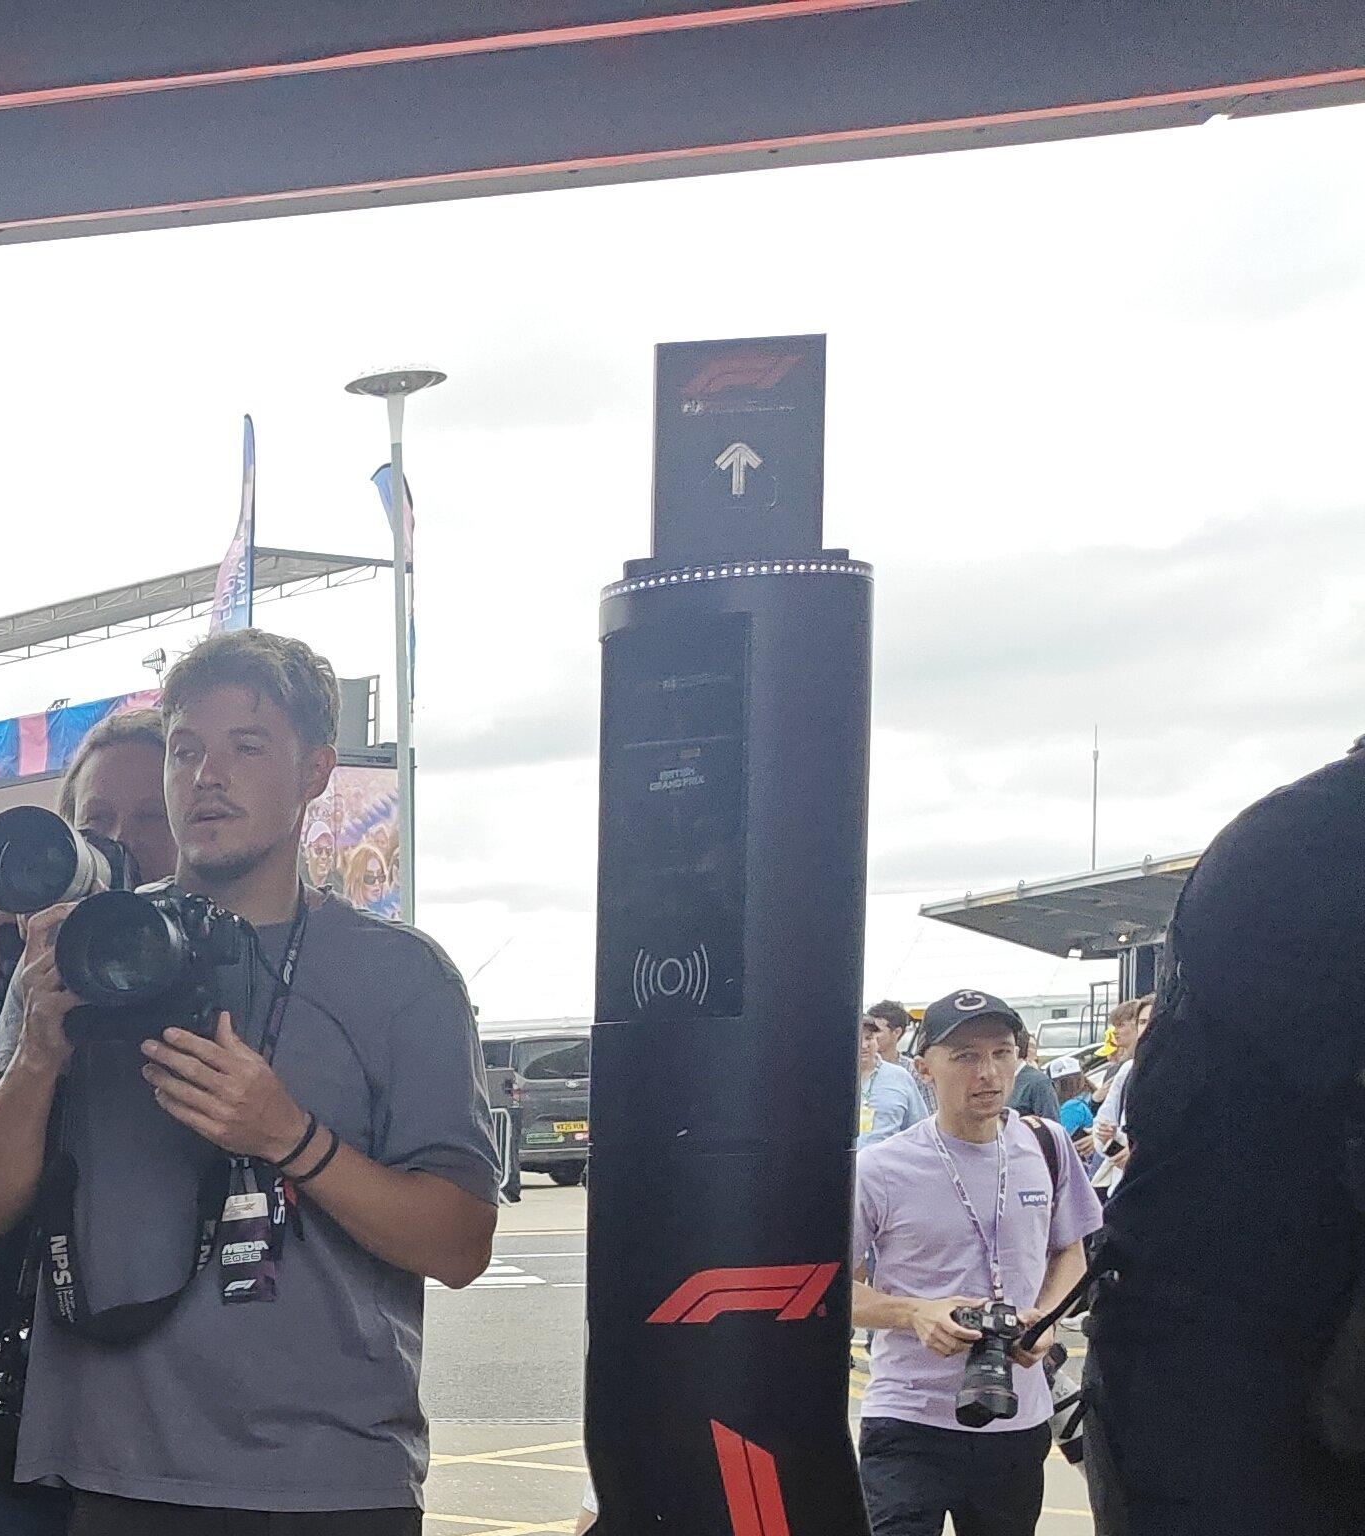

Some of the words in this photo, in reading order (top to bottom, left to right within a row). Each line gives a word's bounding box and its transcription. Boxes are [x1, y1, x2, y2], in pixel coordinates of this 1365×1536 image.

[222, 1240, 269, 1255] MEDIA
[50, 1234, 72, 1287] NPS
[222, 1251, 262, 1265] 2026
